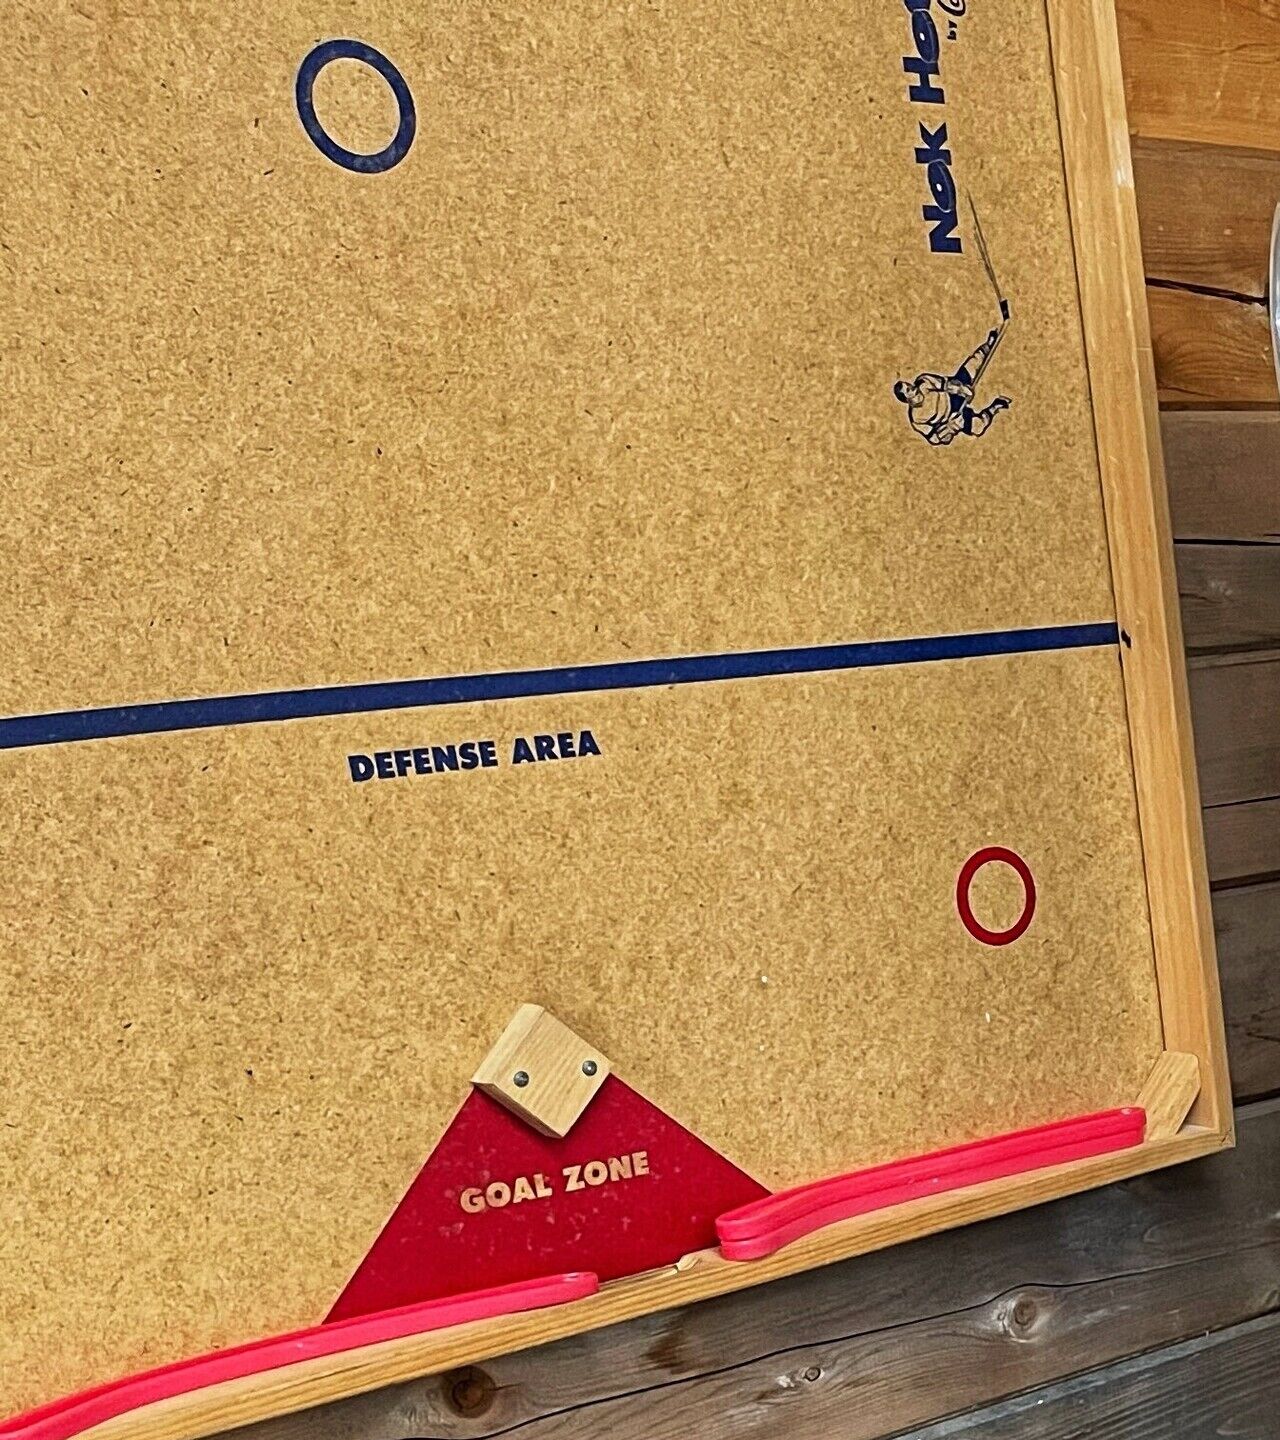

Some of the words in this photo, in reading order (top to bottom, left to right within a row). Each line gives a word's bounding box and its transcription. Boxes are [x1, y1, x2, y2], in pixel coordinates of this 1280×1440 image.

[914, 121, 963, 254] Nok
[347, 741, 499, 782] DEFENSE
[512, 730, 602, 764] AREA
[460, 1163, 553, 1214] GOAL
[562, 1151, 650, 1192] ZONE
